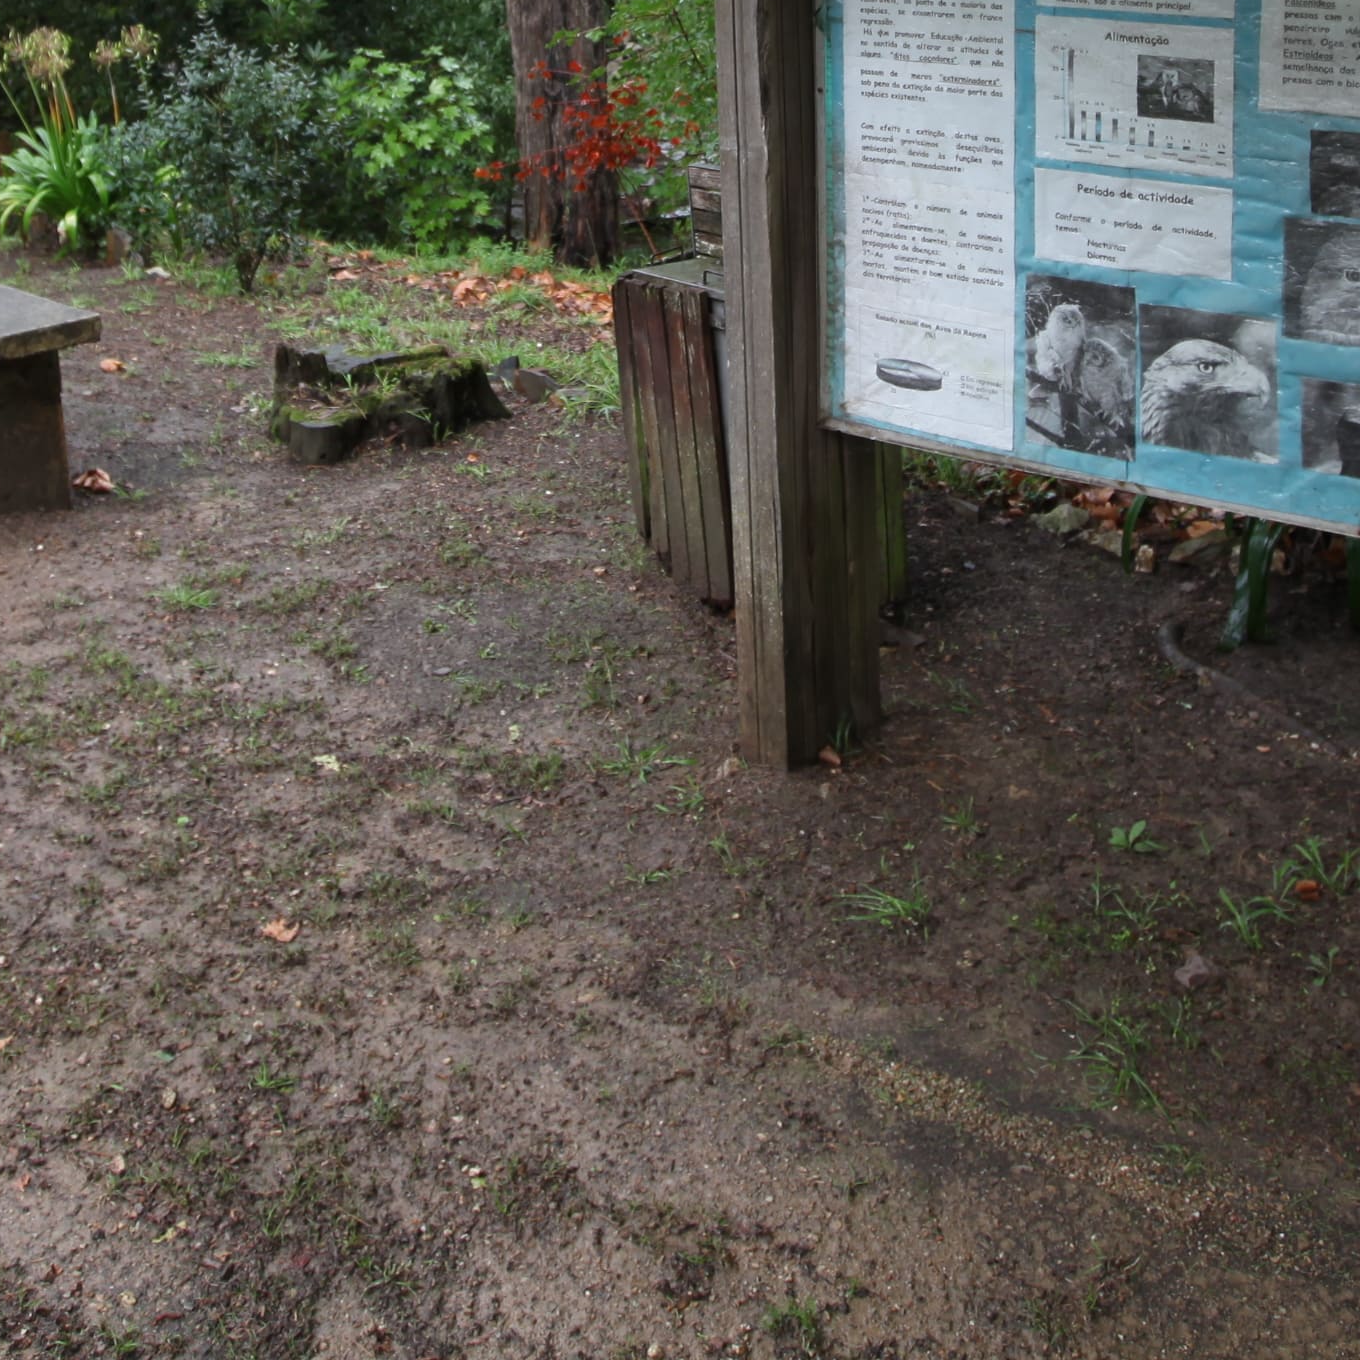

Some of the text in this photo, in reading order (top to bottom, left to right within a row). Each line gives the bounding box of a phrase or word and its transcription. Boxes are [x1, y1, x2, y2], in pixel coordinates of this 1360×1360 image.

[1105, 32, 1169, 46] Alimentação
[1078, 184, 1194, 205] Período de actividade
[1055, 212, 1091, 222] Conforme
[1114, 220, 1142, 230] período
[1172, 226, 1217, 239] actividade,
